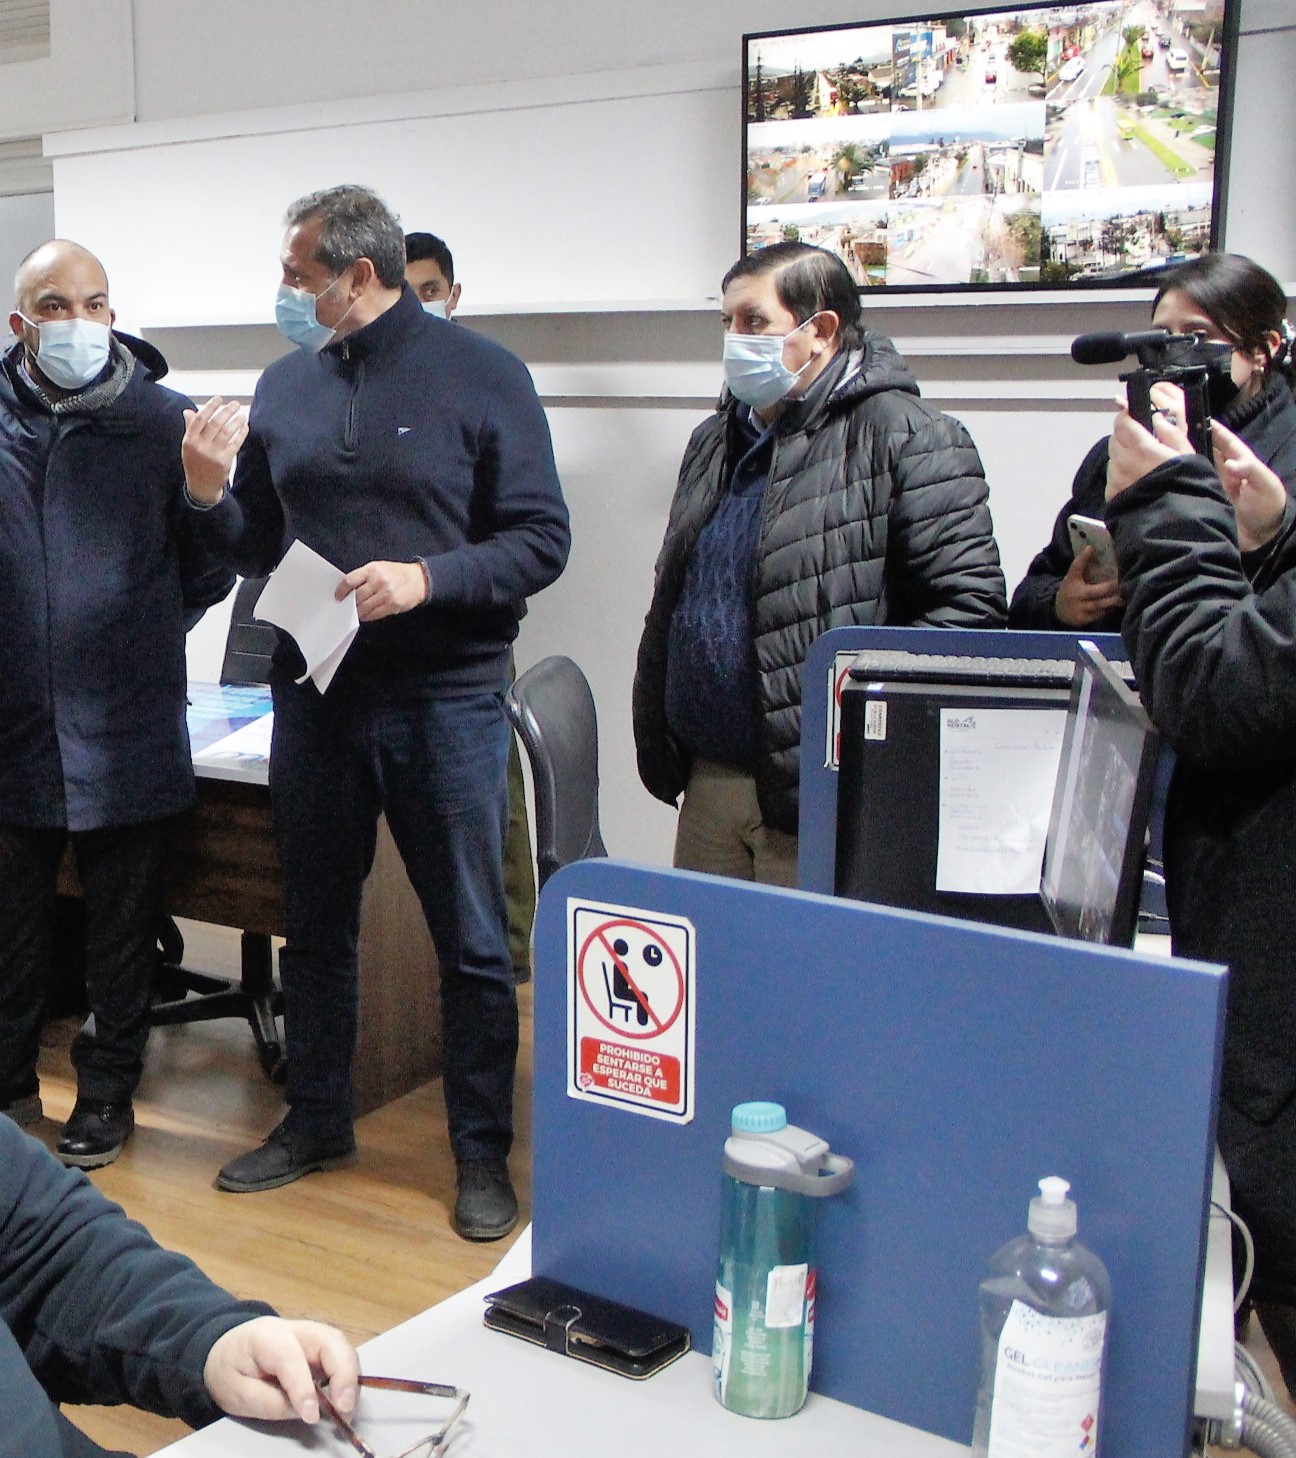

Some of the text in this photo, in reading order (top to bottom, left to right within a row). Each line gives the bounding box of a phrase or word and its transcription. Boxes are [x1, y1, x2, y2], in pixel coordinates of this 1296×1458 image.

[596, 1054, 664, 1078] SENTARSE A
[599, 1043, 661, 1066] PROHIBIDO
[592, 1063, 668, 1090] ESPERAR QUE
[607, 1078, 652, 1097] SUCEDA
[1004, 1345, 1031, 1367] GEL
